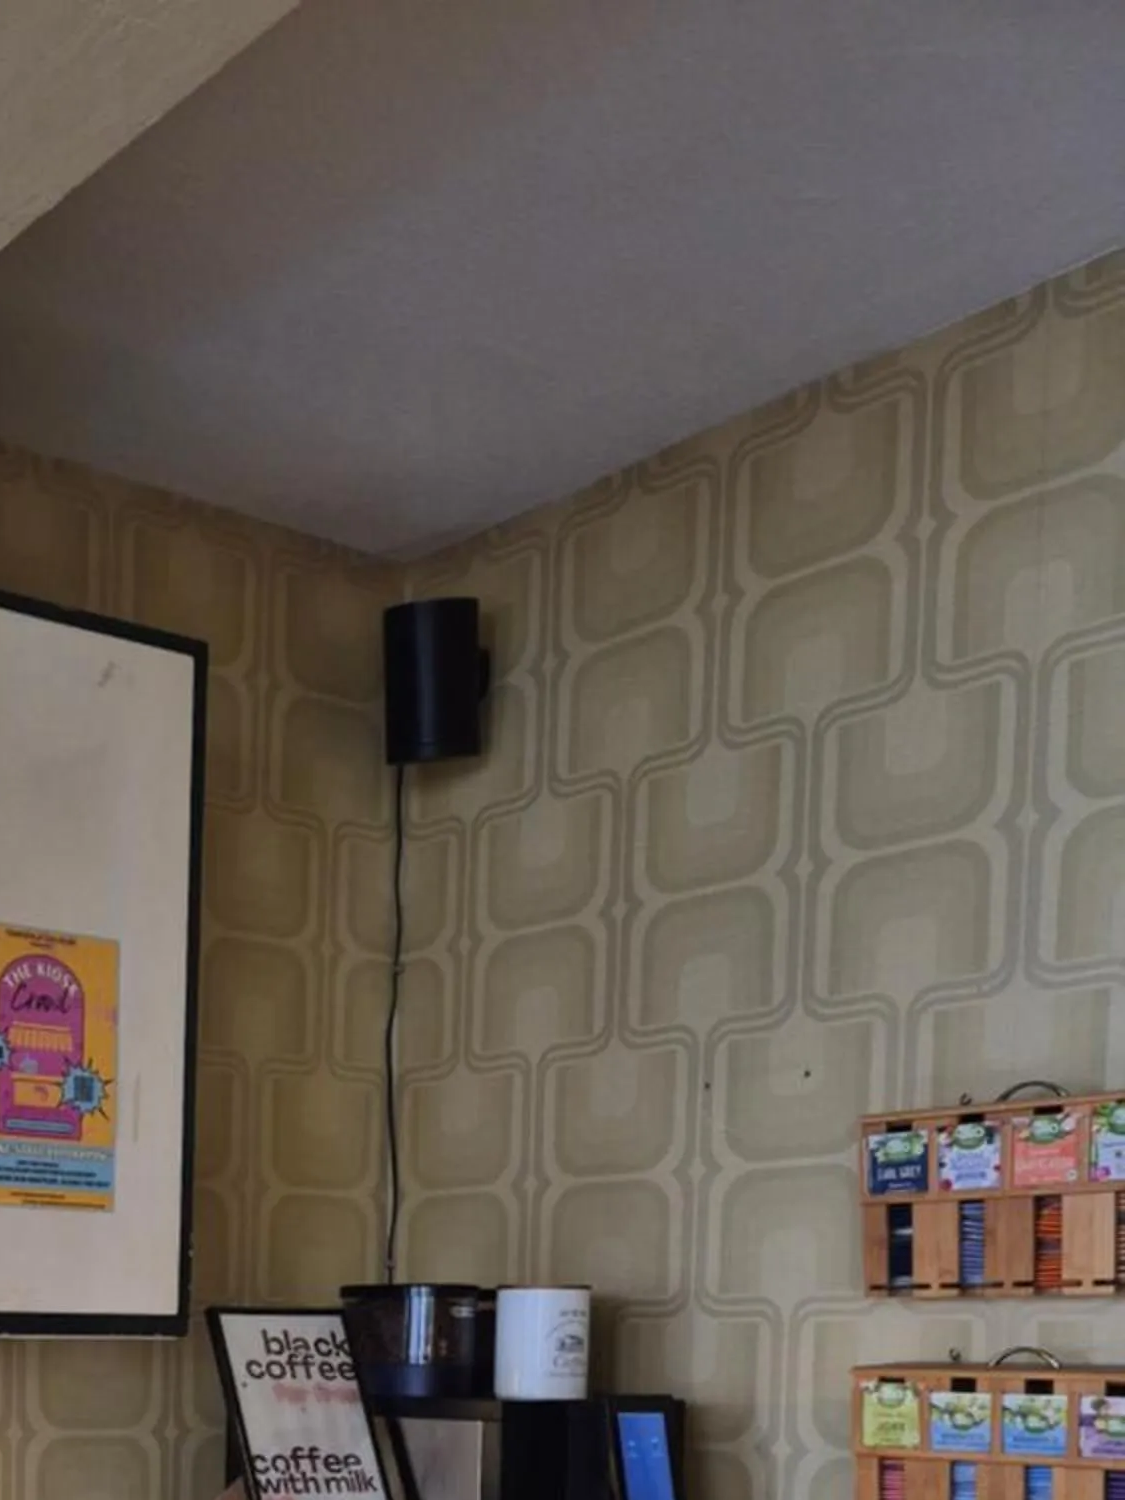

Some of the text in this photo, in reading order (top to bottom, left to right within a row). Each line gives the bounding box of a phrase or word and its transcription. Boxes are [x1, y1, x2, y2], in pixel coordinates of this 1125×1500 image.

[2, 963, 32, 987] THE
[261, 1328, 351, 1357] black
[245, 1353, 358, 1381] coffee
[252, 1446, 363, 1474] coffee
[256, 1469, 378, 1494] with milk
